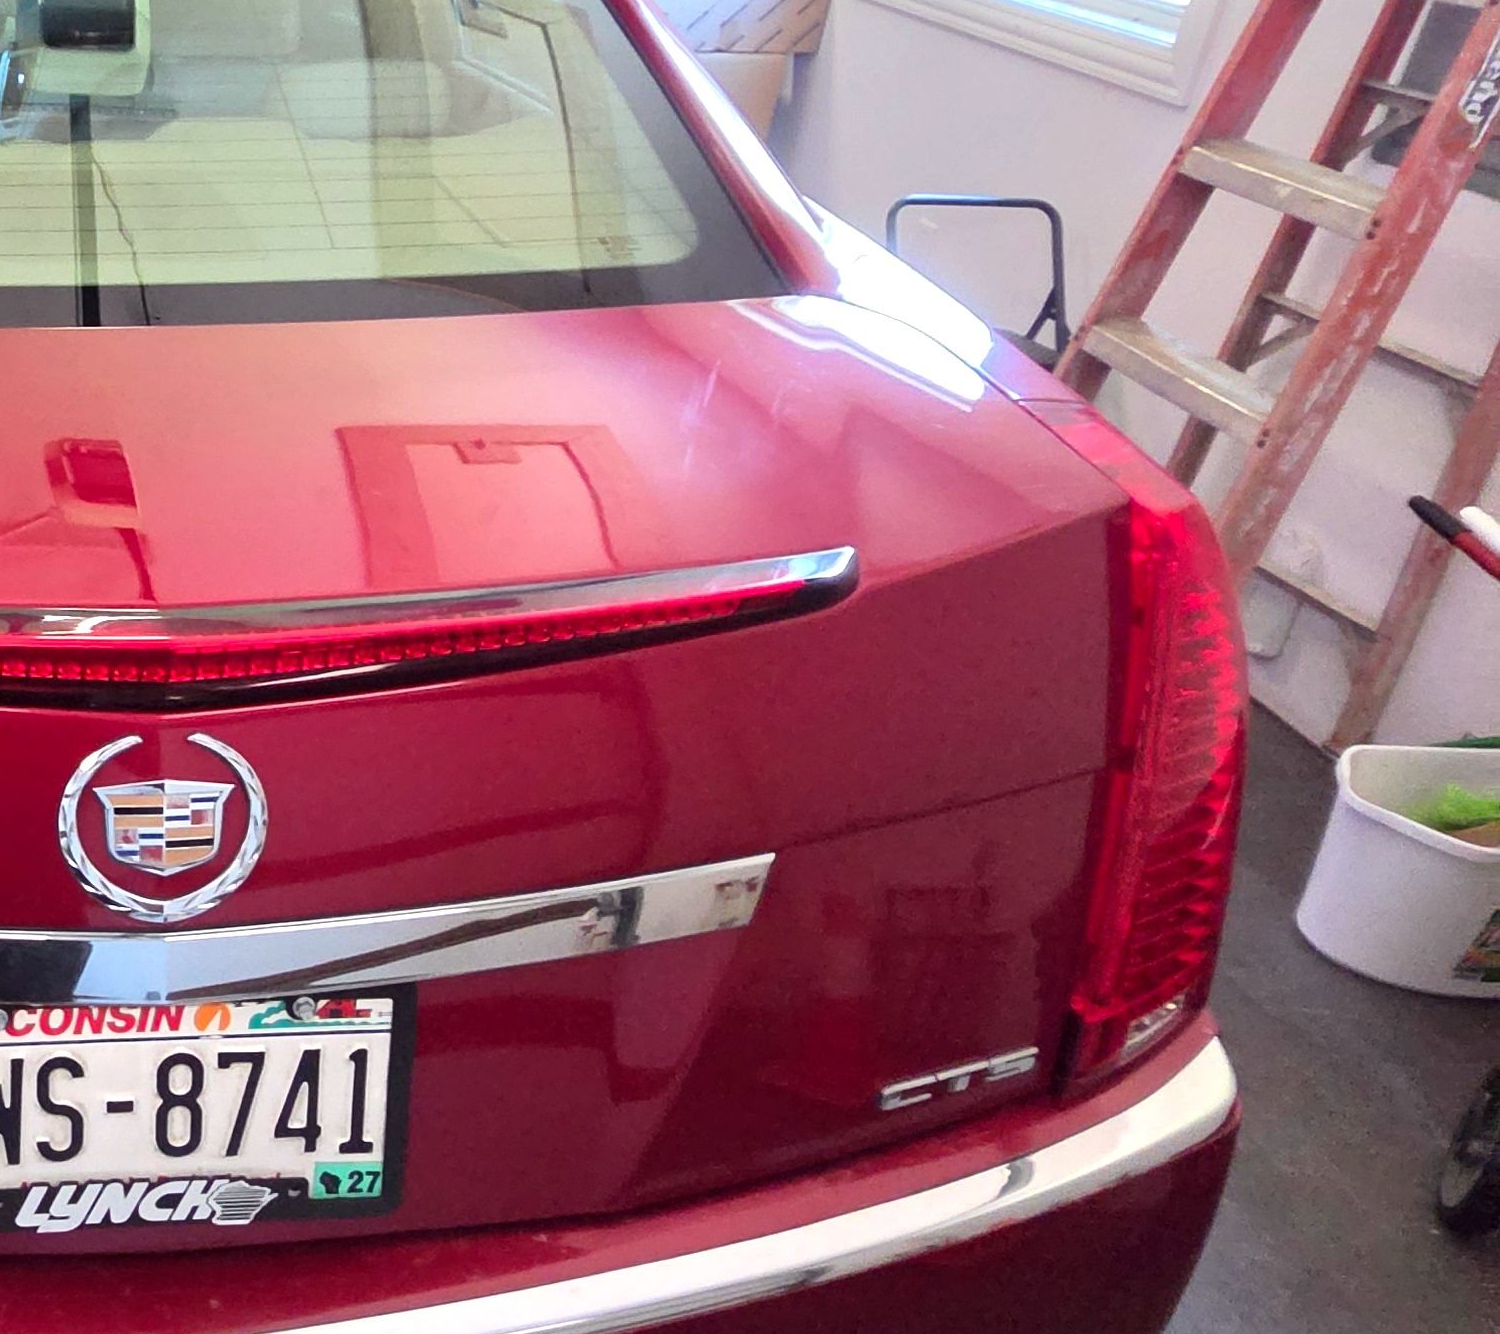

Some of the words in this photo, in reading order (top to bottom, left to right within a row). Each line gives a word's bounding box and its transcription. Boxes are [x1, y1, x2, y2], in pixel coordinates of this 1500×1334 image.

[880, 1046, 1040, 1111] CTS
[15, 1179, 229, 1234] LYNCH
[347, 1169, 381, 1193] 27
